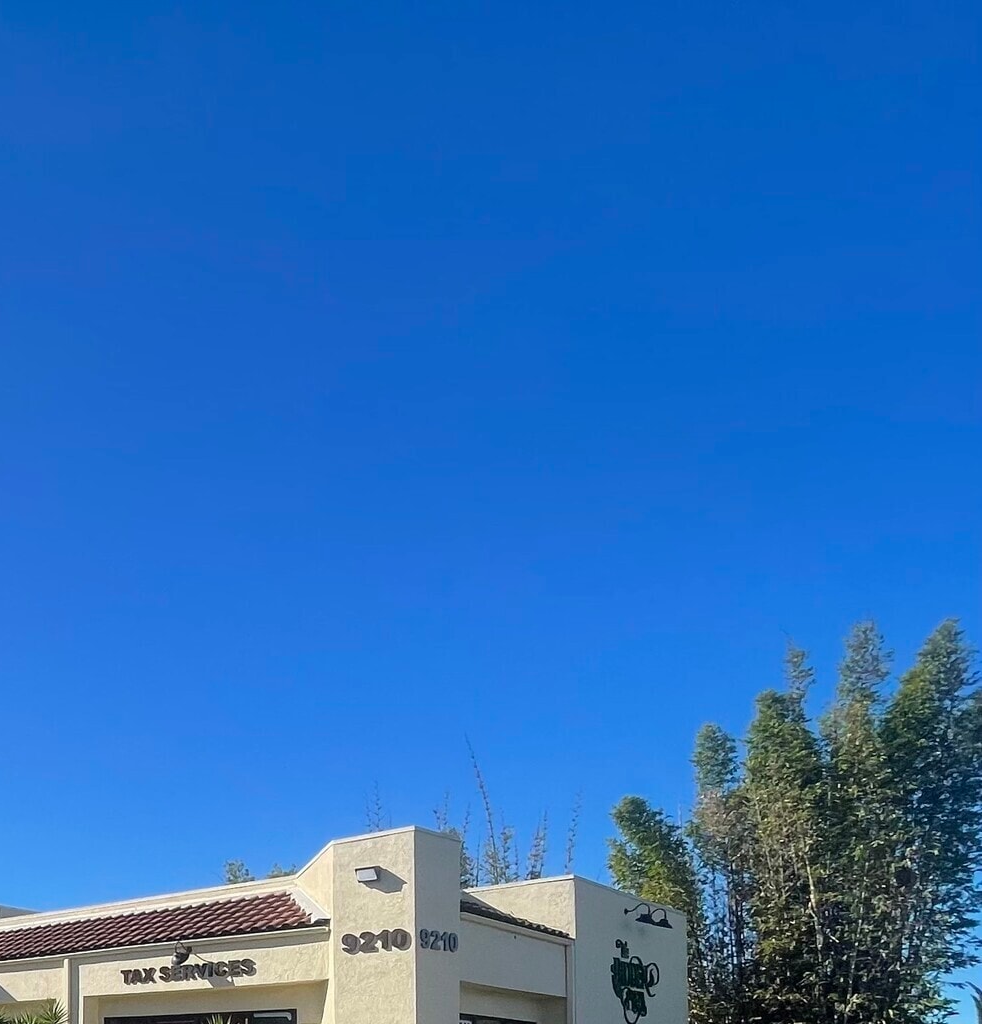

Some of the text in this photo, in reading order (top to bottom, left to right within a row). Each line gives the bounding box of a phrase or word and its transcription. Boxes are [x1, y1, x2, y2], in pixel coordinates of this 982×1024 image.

[341, 928, 412, 955] 9210
[419, 928, 459, 953] 9210
[121, 958, 257, 986] TAX SERVICES
